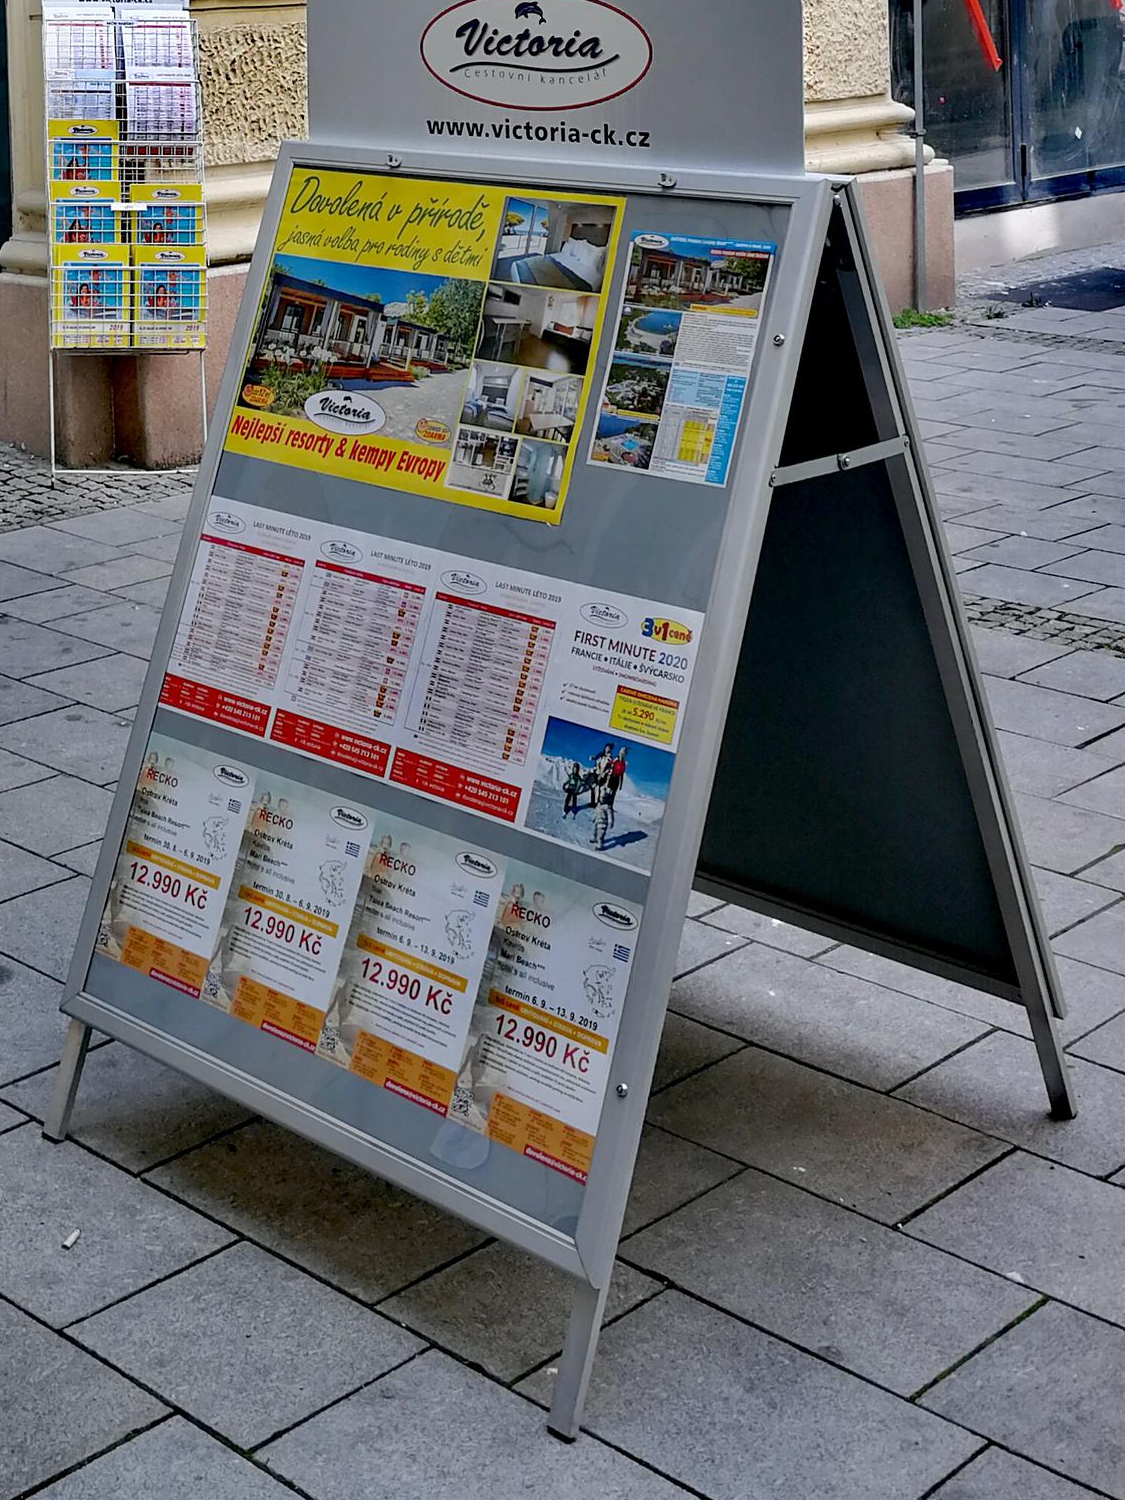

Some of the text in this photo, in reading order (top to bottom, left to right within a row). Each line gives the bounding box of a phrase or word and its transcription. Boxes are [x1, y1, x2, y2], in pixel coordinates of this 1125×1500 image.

[456, 19, 603, 58] Victoria
[427, 118, 651, 147] www.victoria-ck.cz
[290, 176, 490, 241] Dovolená v přírodě,
[277, 225, 488, 271] jasná volba pro rodiny s dětmi
[319, 397, 371, 420] Victoria
[231, 415, 445, 482] Nejlepší resorty & kempy Evropy
[253, 521, 265, 530] LAST
[266, 523, 285, 536] MINUTE
[371, 550, 383, 559] LAST
[384, 552, 404, 565] MINUTE
[405, 557, 418, 567] LÉTO
[495, 581, 562, 603] LAST MINUTE LÉTO 2019
[590, 605, 620, 620] Victoria
[669, 629, 692, 643] ceně
[574, 630, 688, 670] FIRST MINUTE 2020
[571, 647, 685, 684] FRANCIE ITÁLIE ŠVÝCARSKO
[632, 707, 655, 721] 5.290
[147, 765, 179, 788] ŘECKO
[259, 806, 294, 830] ŘECKO
[254, 829, 293, 850] Ostrov Kréta
[196, 855, 211, 865] 2019
[379, 851, 416, 876] ŘECKO
[130, 862, 208, 910] 12.990 Kč
[374, 874, 416, 897] Ostrov Kréta
[275, 890, 330, 918] 30. 2019
[385, 902, 403, 914] Beach
[511, 901, 551, 929] ŘECKO
[244, 907, 295, 943] 12.990
[299, 929, 322, 955] Kč
[505, 926, 551, 951] Ostrov Kréta
[420, 944, 430, 956] 13.
[438, 951, 455, 964] 2019
[362, 957, 454, 1015] 12.990 Kč
[557, 1006, 568, 1019] 13.
[578, 1015, 598, 1032] 2019
[496, 1014, 557, 1058] 12.990
[563, 1043, 590, 1073] Kč
